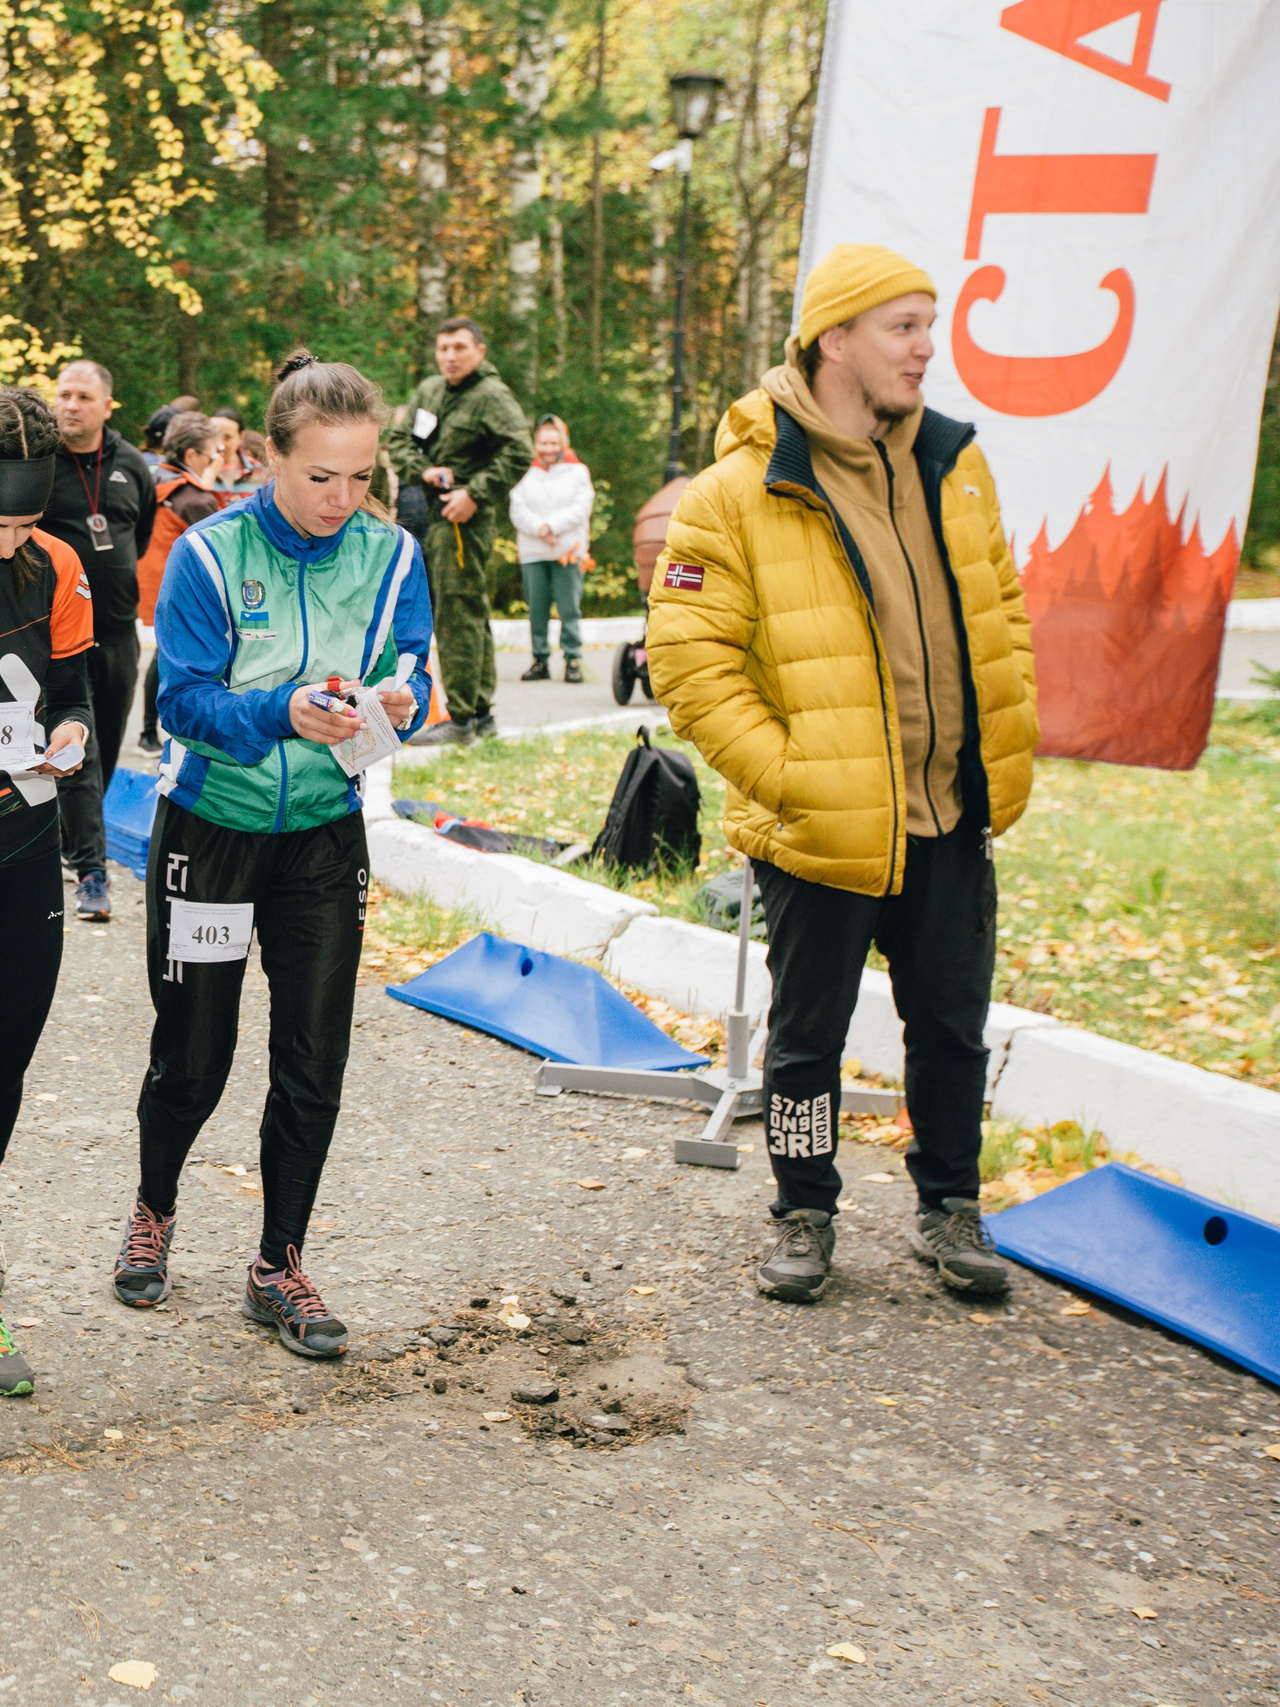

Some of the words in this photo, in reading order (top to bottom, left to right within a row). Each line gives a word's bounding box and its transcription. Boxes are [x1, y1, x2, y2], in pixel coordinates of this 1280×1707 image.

[191, 925, 230, 945] 403
[770, 1093, 811, 1116] S7R
[769, 1128, 812, 1159] 3R
